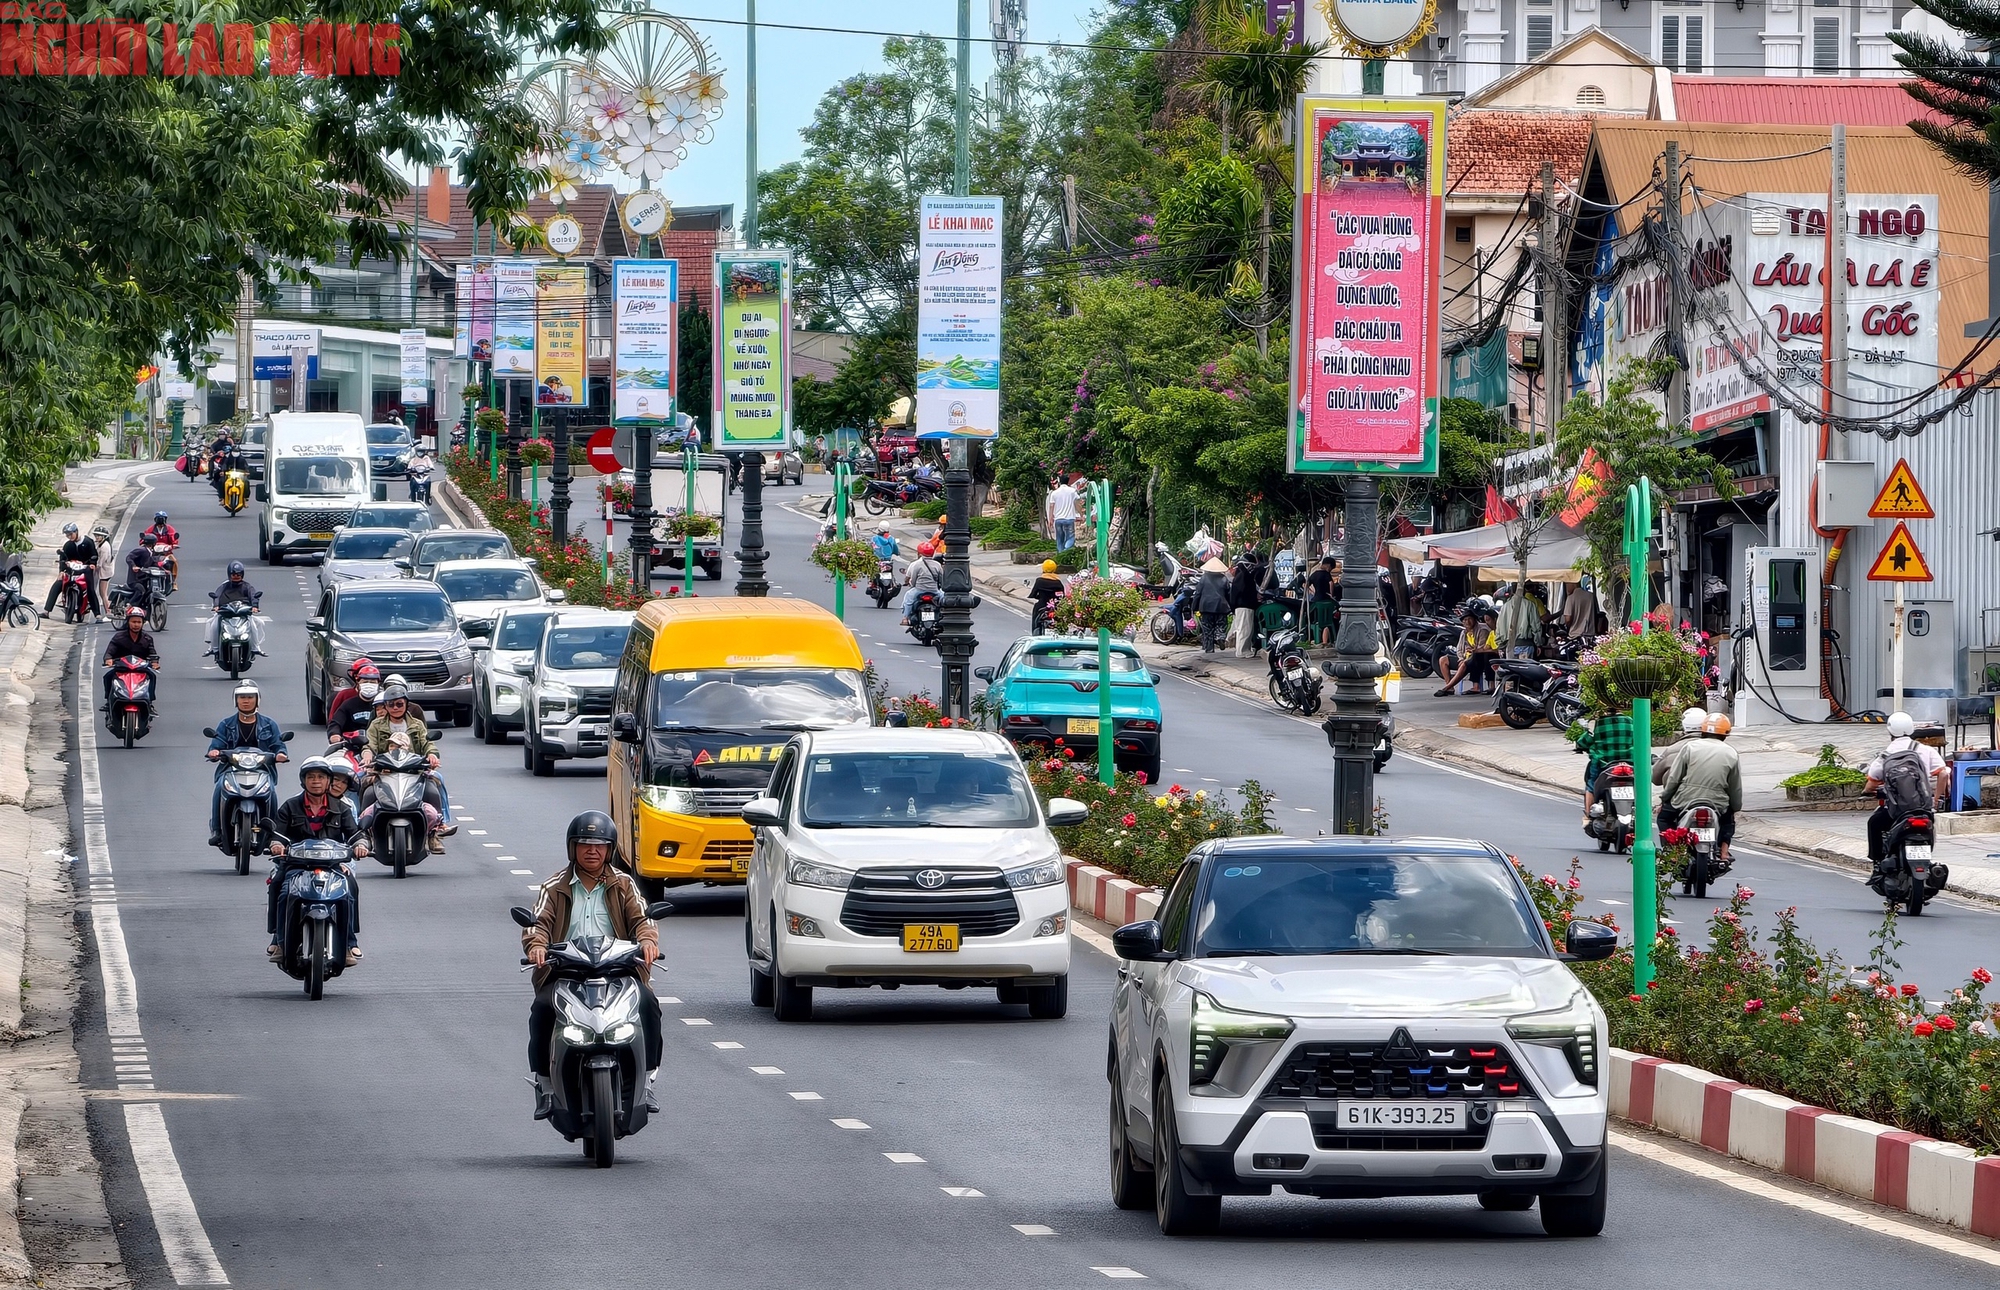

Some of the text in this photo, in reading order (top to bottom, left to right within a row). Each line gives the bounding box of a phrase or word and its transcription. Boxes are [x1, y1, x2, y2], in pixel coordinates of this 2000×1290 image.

[928, 213, 994, 232] LỄ KHAI MẠC
[1361, 216, 1380, 234] VUA
[1383, 213, 1412, 235] HÙNG
[1786, 203, 1926, 242] TA NGỘ
[1356, 248, 1370, 270] CÓ
[1373, 248, 1401, 270] CÔNG
[1866, 259, 1903, 287] LÁ
[1910, 259, 1931, 287] É
[1337, 283, 1401, 308] DỰNG NƯỚC,
[754, 313, 761, 322] AI
[1862, 301, 1920, 336] Gốc
[1335, 318, 1402, 340] BÁC CHÁU TA
[1323, 350, 1411, 376] PHẢI CÙNG NHAU
[1865, 347, 1880, 362] ĐÀ
[1348, 386, 1367, 409] LẤY
[719, 746, 763, 762] AN
[919, 925, 942, 937] 49A
[910, 939, 952, 950] 277.60
[1349, 1107, 1455, 1124] 61K-393.25
